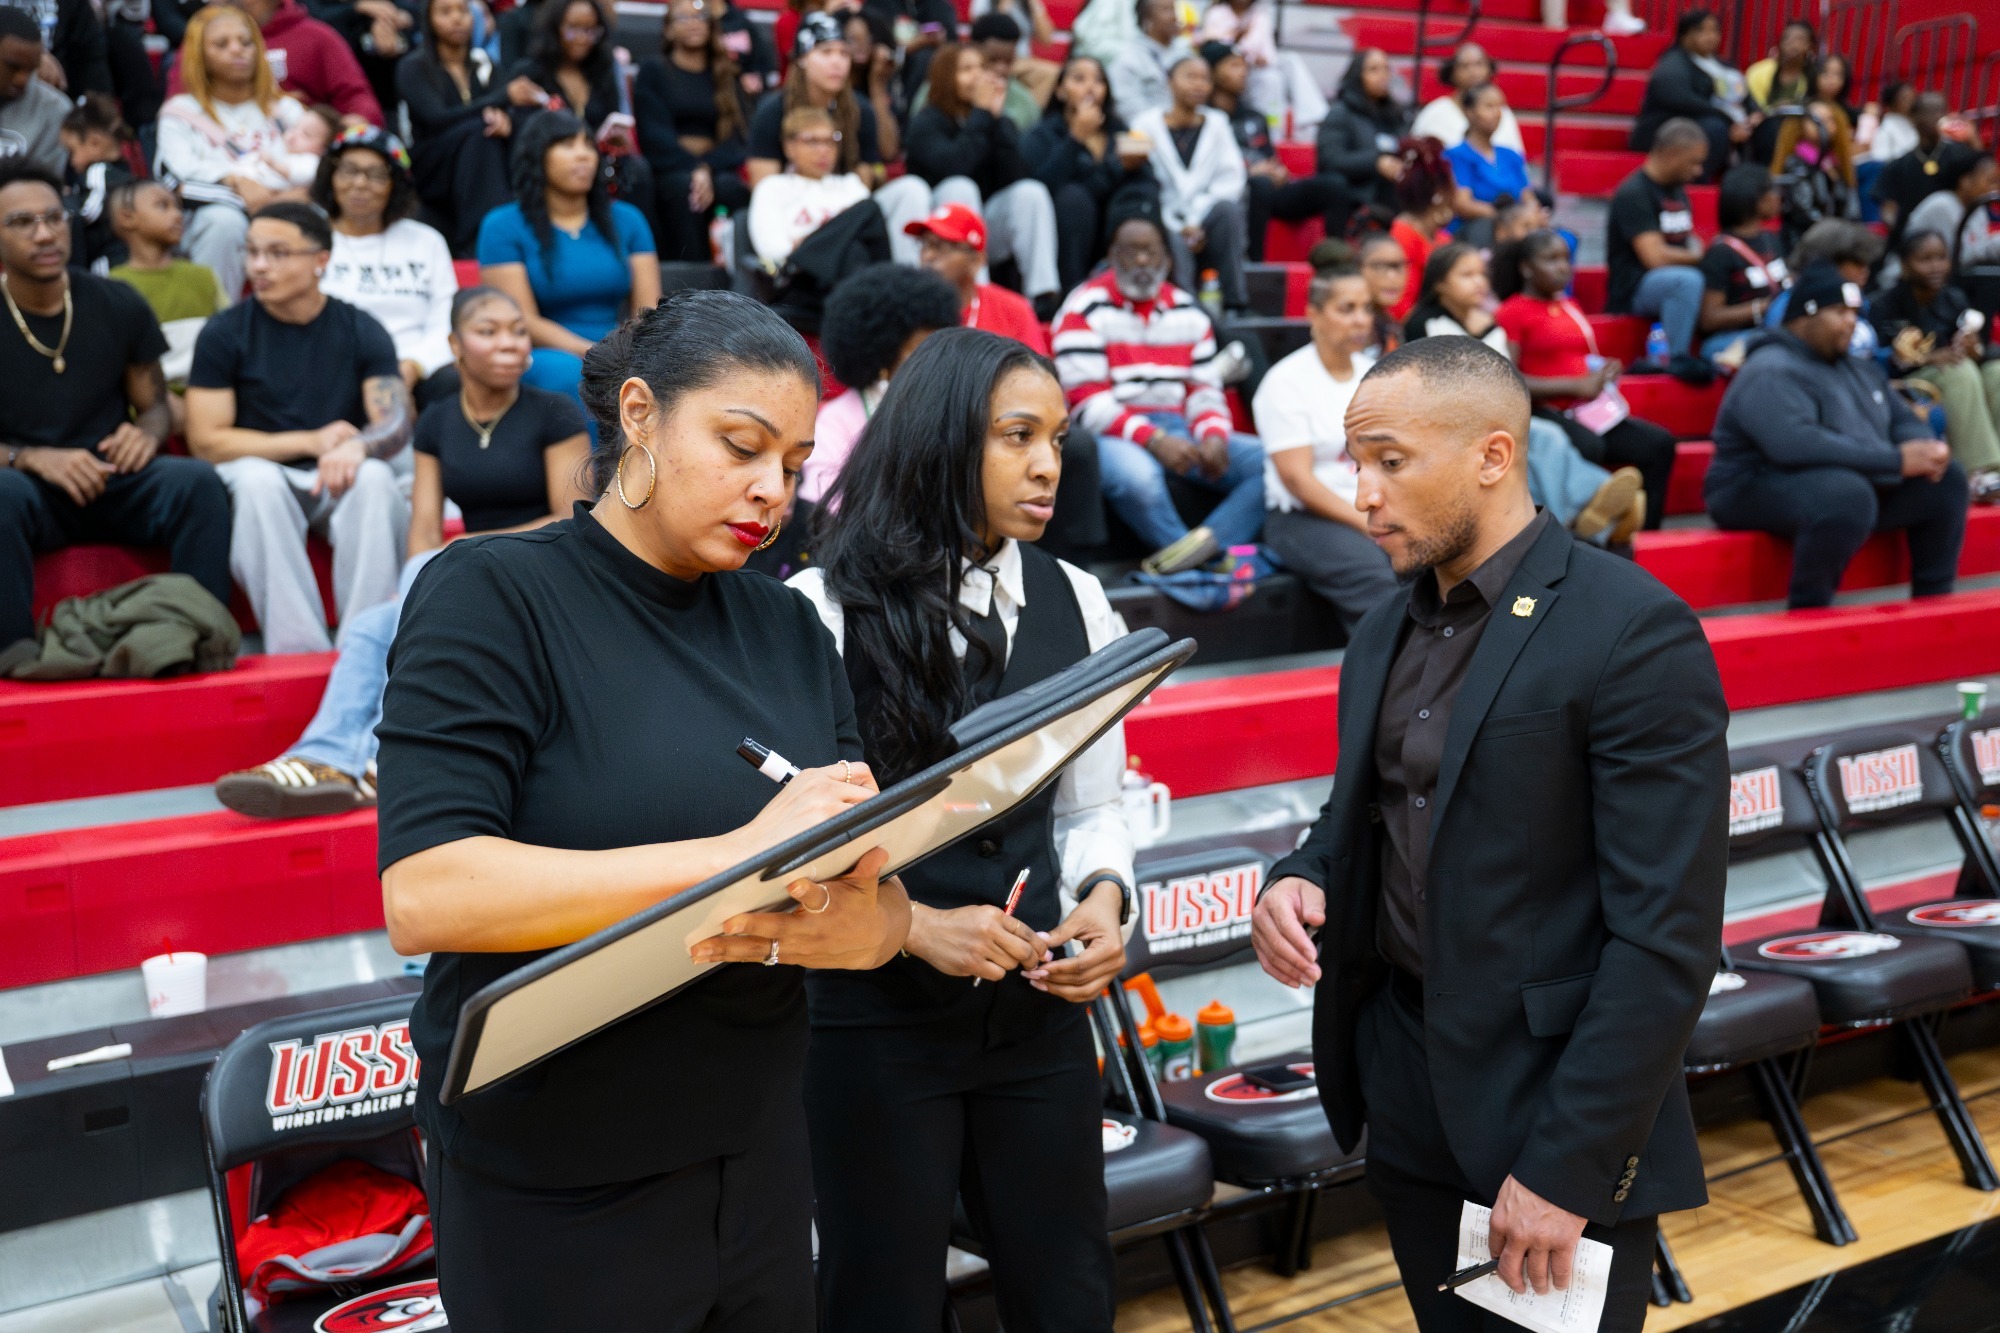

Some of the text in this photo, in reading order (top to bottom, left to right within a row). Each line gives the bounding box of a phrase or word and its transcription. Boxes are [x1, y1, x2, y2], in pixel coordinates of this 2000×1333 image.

[1730, 765, 1781, 823] SSU
[1837, 743, 1921, 800] WSSU
[1139, 861, 1265, 941] WSSU
[266, 1018, 421, 1117] WSS
[272, 1093, 402, 1132] WINSTON-SALEM
